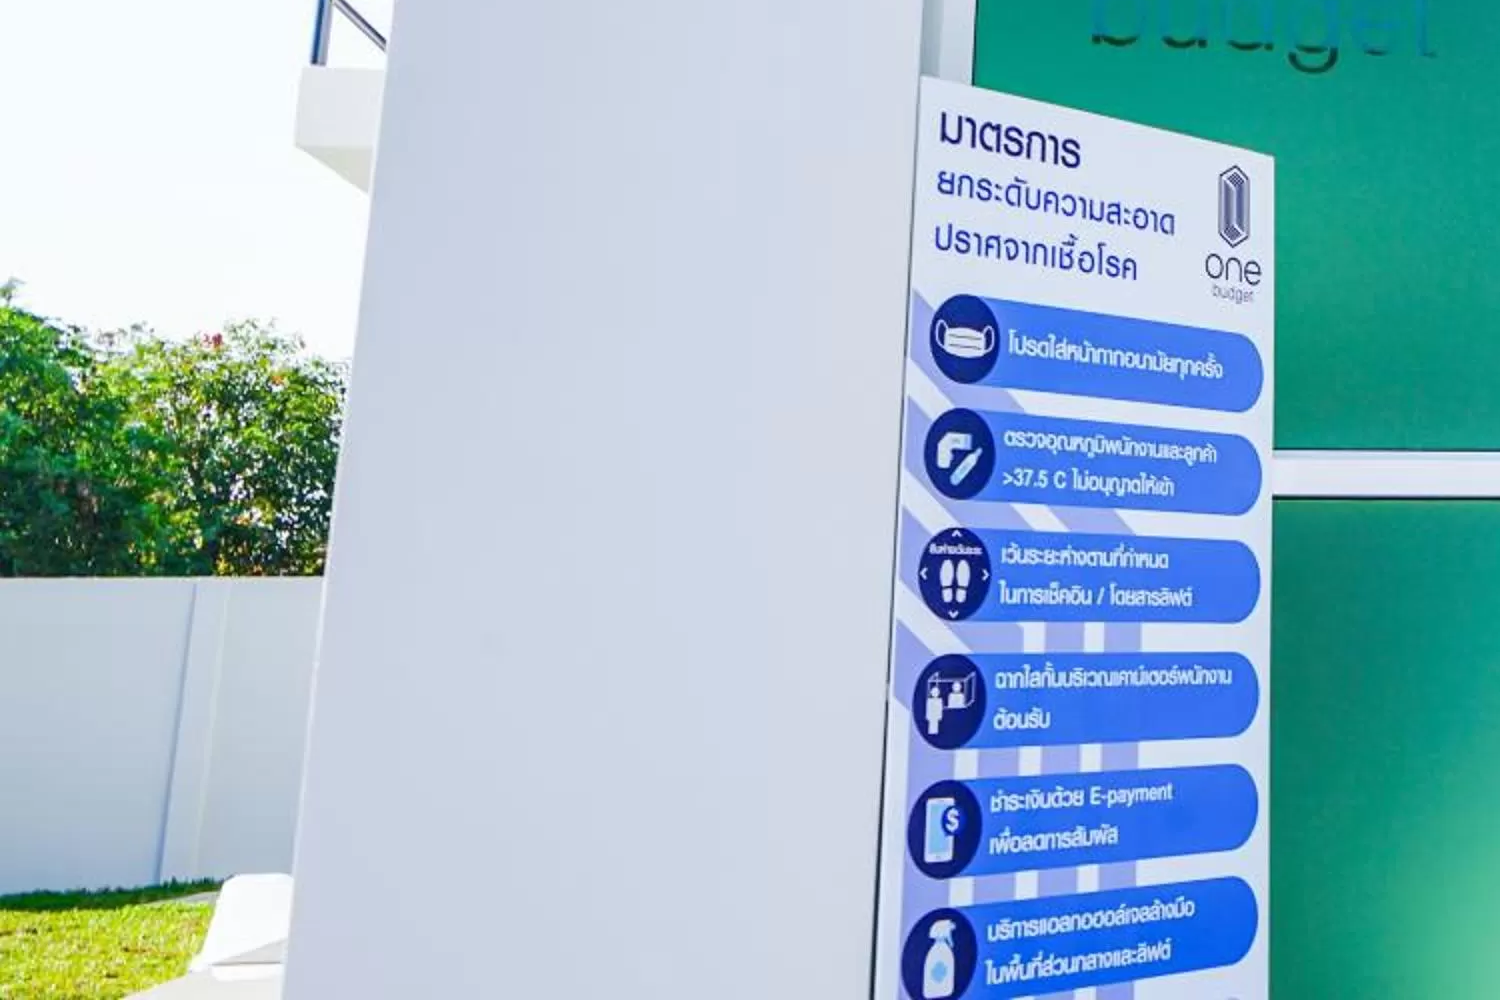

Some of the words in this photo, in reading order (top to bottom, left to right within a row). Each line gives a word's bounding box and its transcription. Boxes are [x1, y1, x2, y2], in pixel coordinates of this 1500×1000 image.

[939, 110, 1081, 168] มาตรการ
[936, 170, 1176, 235] ยกระดับความสะอาด
[934, 222, 1137, 281] ปราศจากเชื้อโรค
[1205, 253, 1262, 286] one
[1007, 329, 1224, 380] โปรดใส่หน้ากากอนามัยทุกครั้ง
[1053, 471, 1067, 489] C
[1000, 542, 1169, 569] เว้นระยะห่างตามที่กำหนด
[998, 580, 1093, 606] ในการเช็คอิน
[993, 706, 1051, 730] ต้อนรับ
[990, 787, 1085, 813] ชำระเงินด้วย
[1090, 783, 1173, 808] E-payment
[989, 824, 1119, 855] เพื่อลดการสัมผัส
